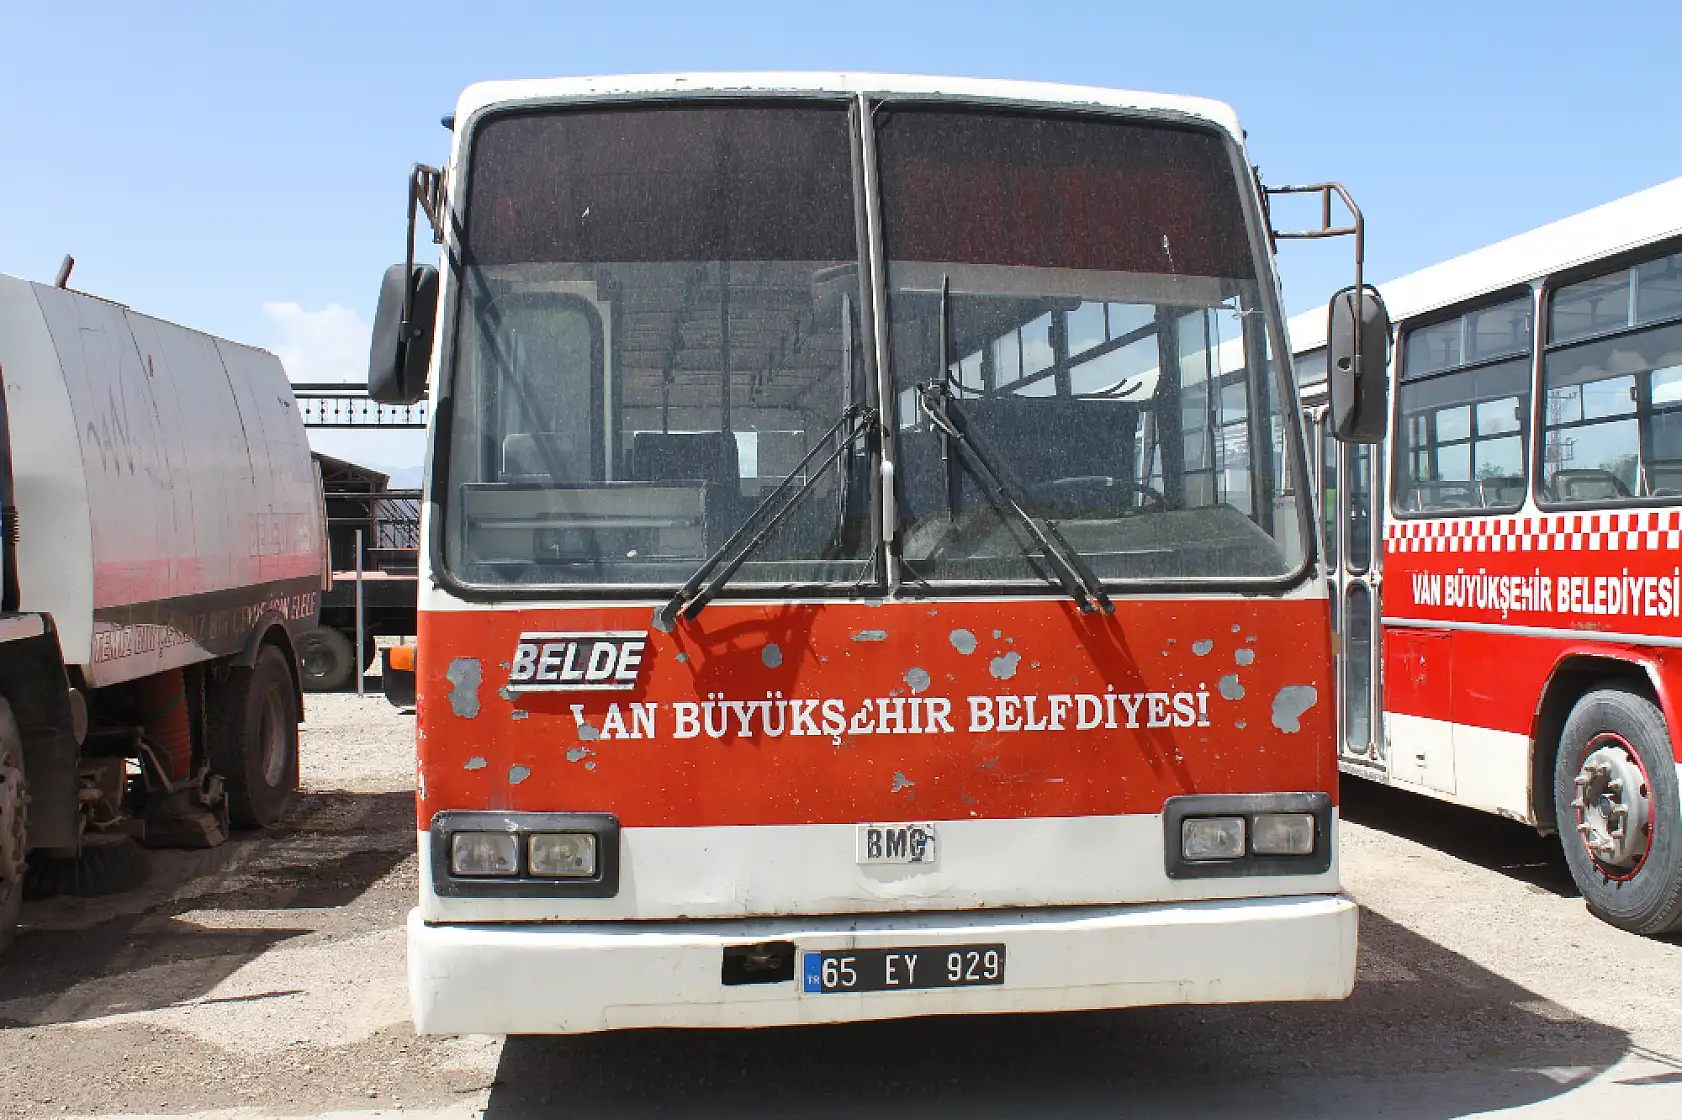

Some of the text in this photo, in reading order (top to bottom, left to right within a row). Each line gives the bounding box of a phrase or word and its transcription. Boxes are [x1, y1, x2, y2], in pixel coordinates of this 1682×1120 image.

[1412, 567, 1680, 619] VAN BÜYÜKŞEHİR BELEDİYESİ
[508, 641, 646, 681] BELDE
[823, 957, 857, 988] 65
[885, 954, 918, 985] EY
[947, 951, 999, 982] 929
